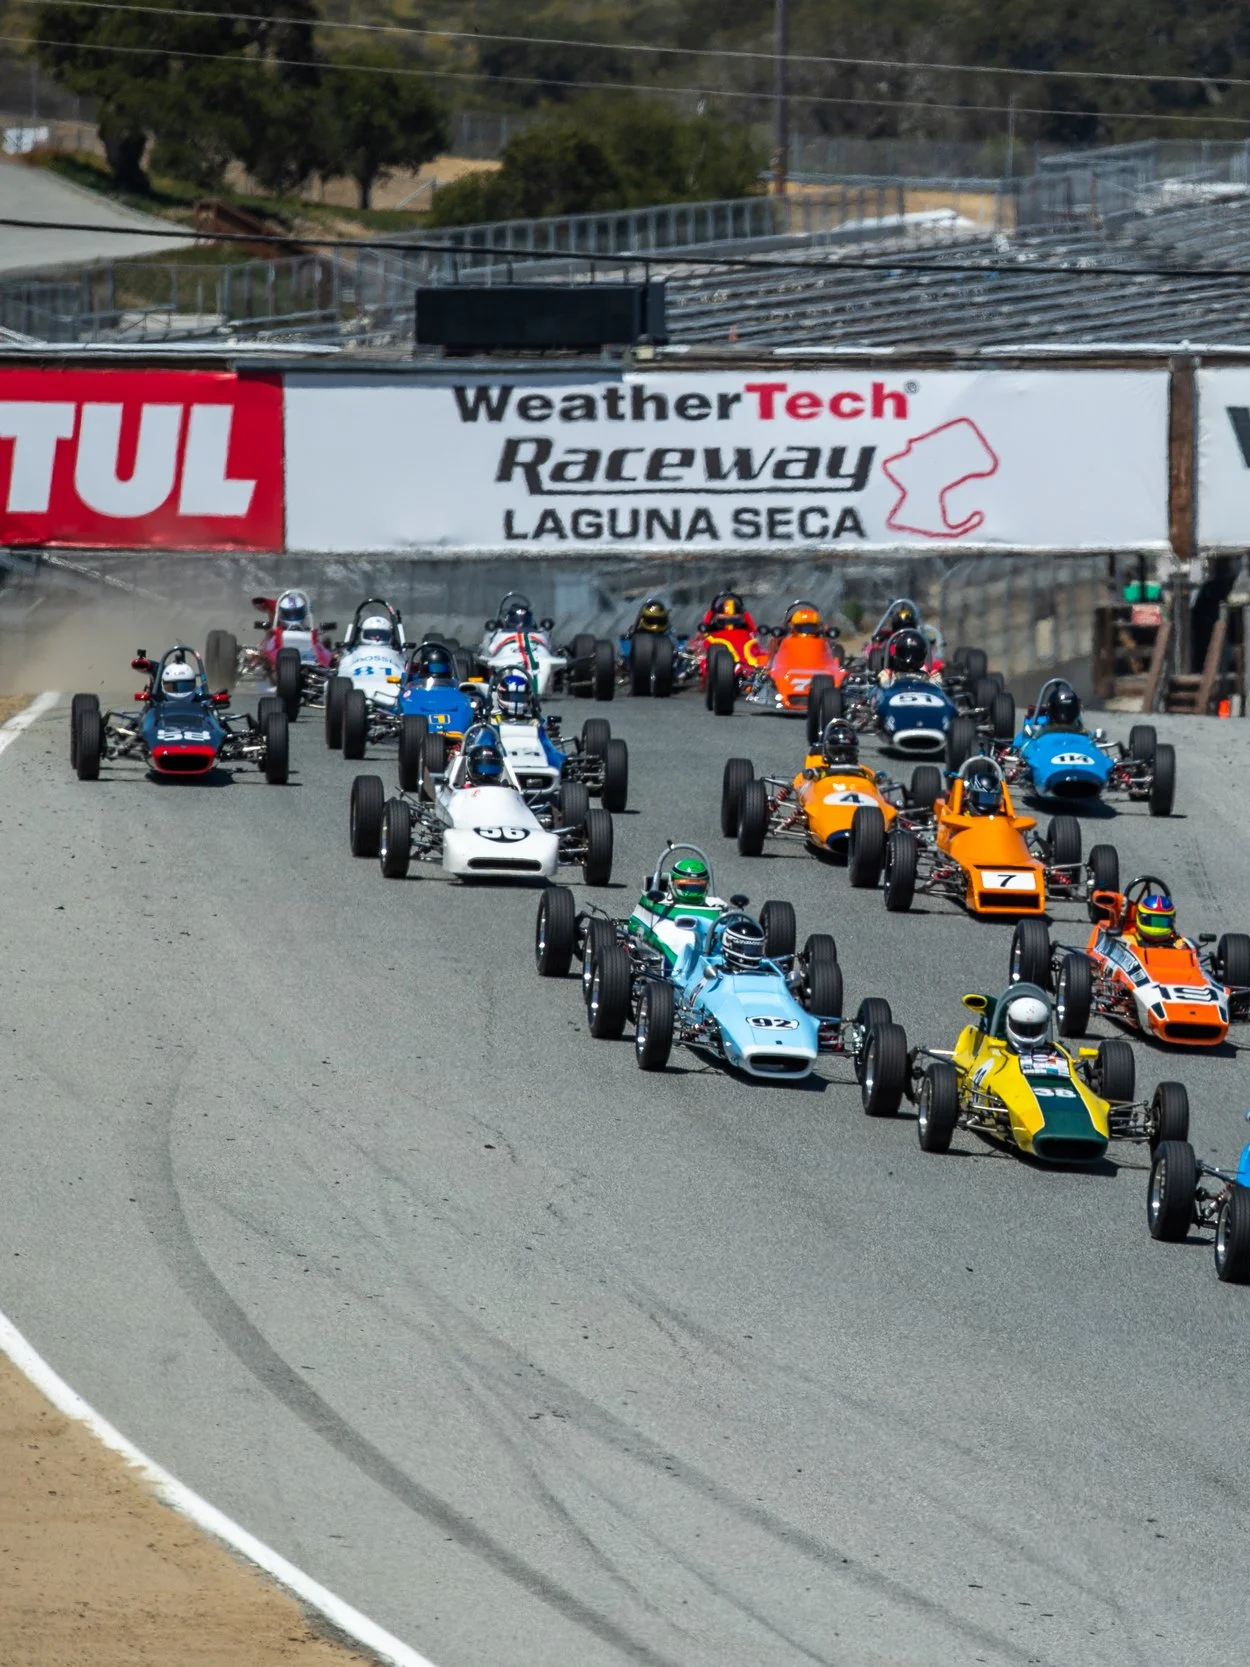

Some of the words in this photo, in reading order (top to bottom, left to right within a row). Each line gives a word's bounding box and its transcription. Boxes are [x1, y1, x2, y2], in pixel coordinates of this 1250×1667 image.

[494, 435, 877, 496] Raceway
[503, 506, 721, 542] LAGUNA
[731, 506, 867, 541] SECA
[839, 792, 865, 804] 4
[996, 873, 1018, 888] 7
[751, 1017, 794, 1029] 92
